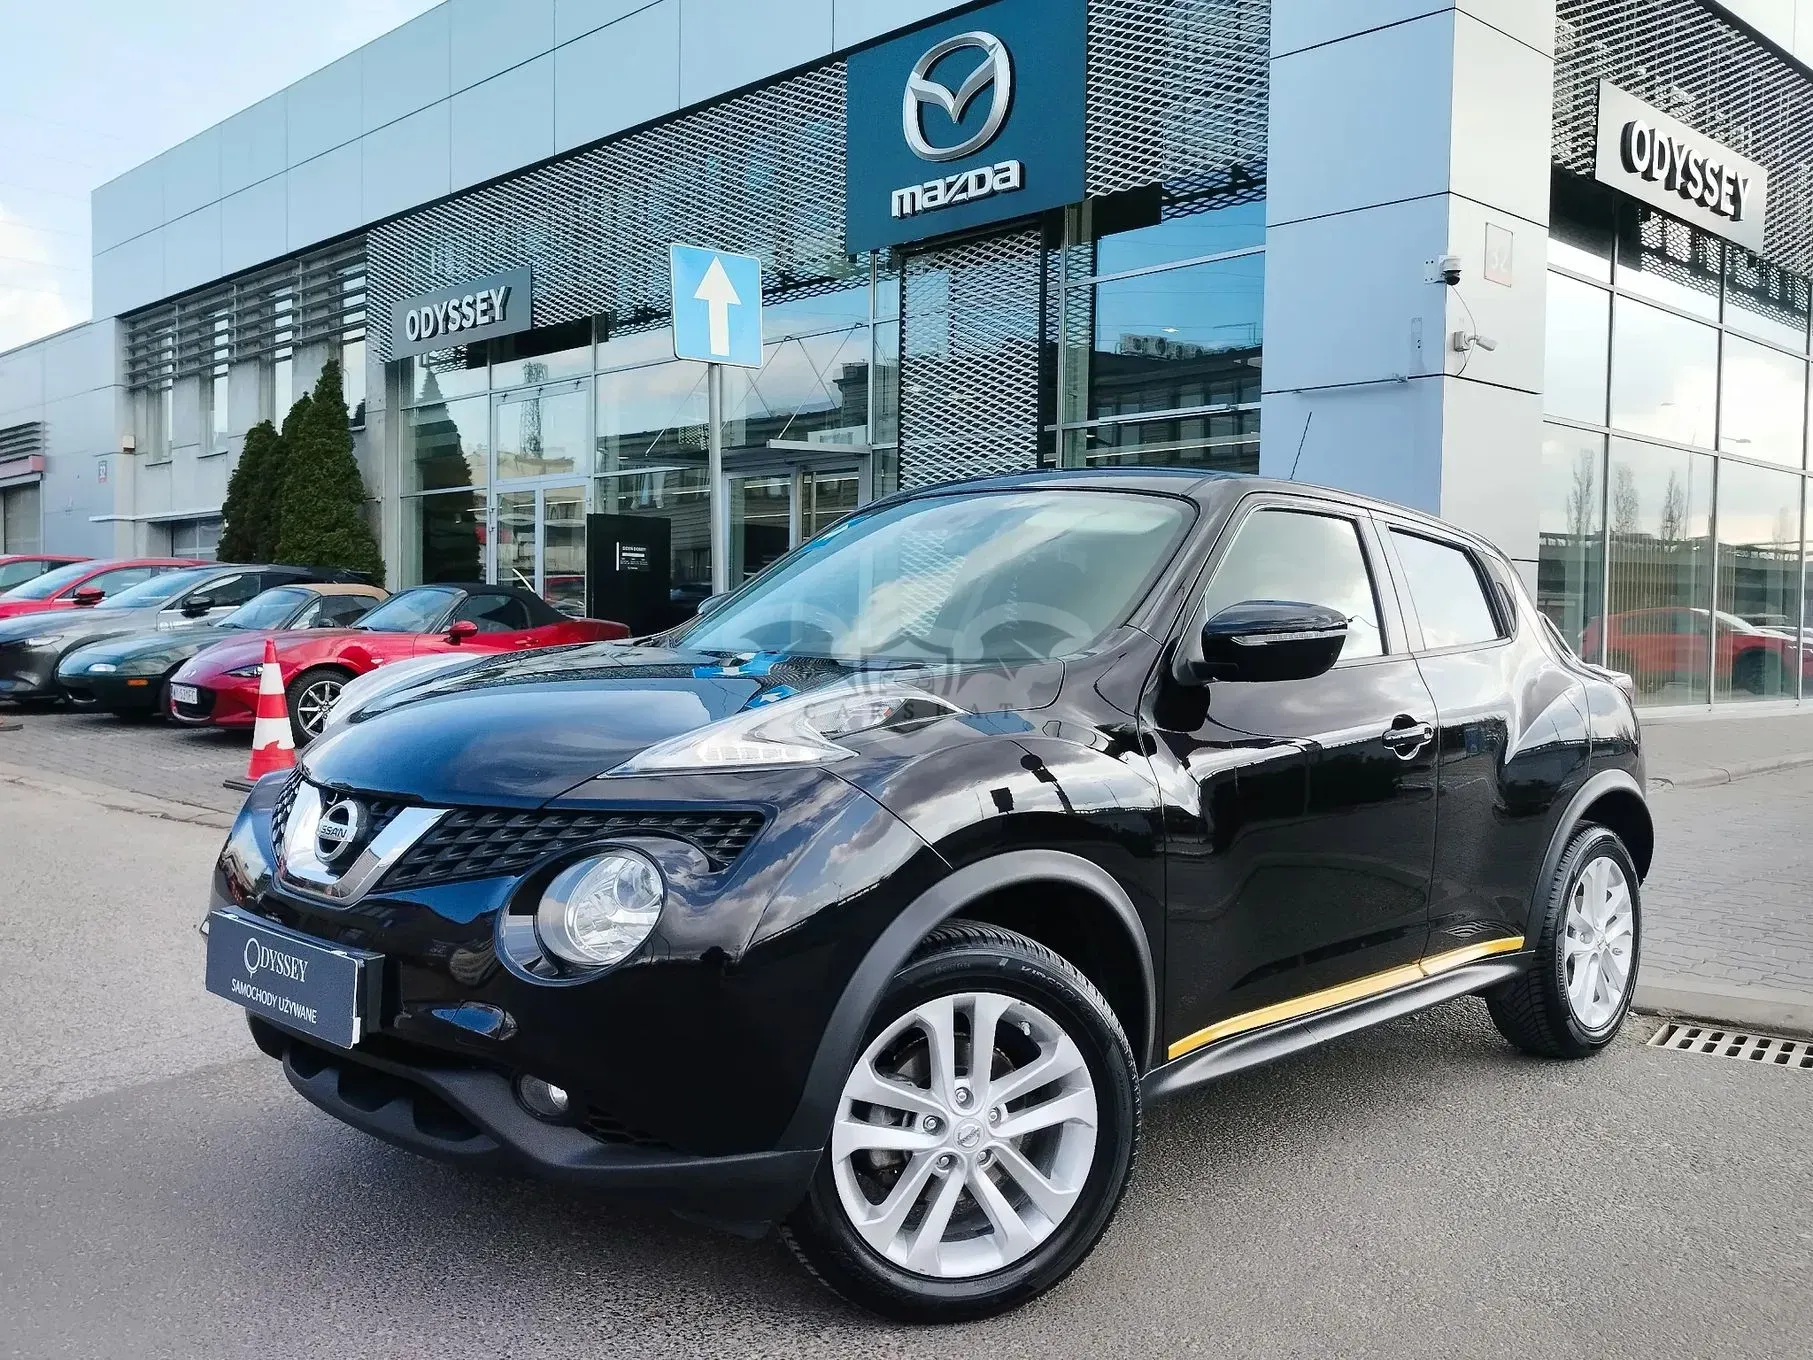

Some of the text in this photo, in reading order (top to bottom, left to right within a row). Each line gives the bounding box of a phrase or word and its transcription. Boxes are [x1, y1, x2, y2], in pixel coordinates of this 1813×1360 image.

[1620, 119, 1752, 222] ODYSSEY
[405, 285, 508, 341] ODYSSEY
[320, 825, 348, 838] SSAN
[243, 937, 309, 983] ODYSSEY
[231, 978, 318, 1024] SAMOCHODY UŻYWANE
